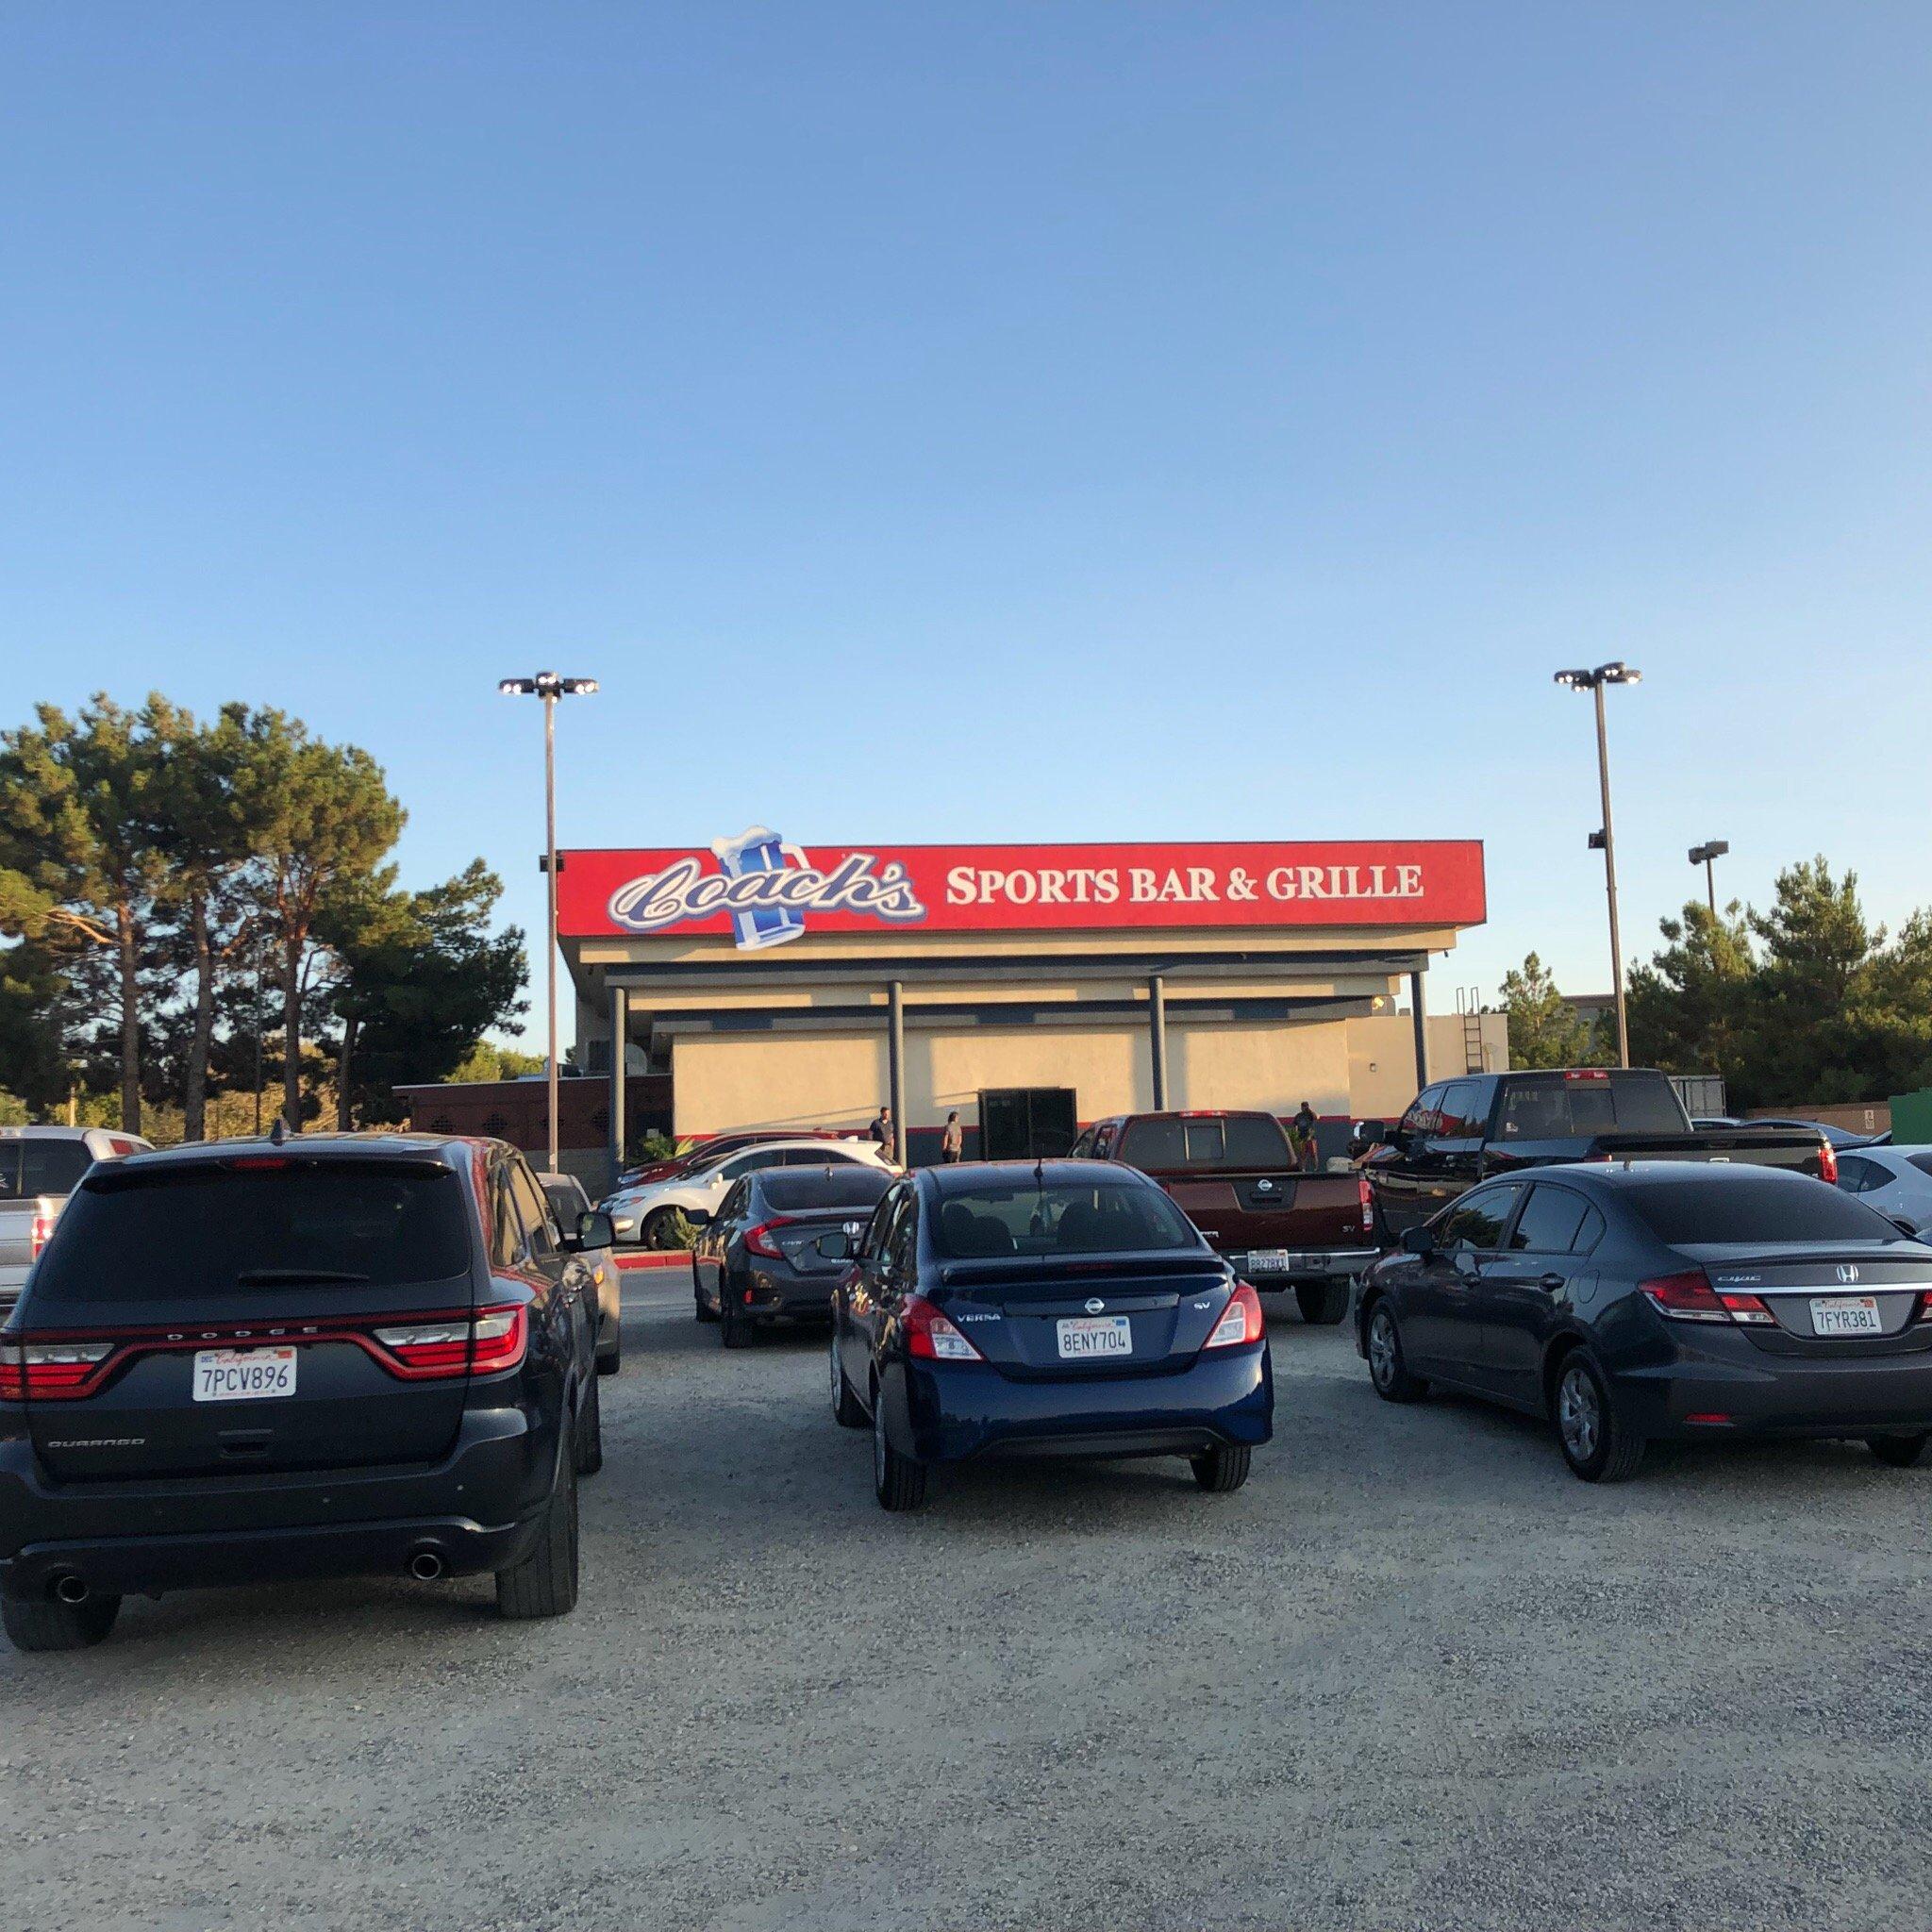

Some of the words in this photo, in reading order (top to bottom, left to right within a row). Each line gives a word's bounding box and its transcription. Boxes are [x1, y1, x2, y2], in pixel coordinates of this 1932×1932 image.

[608, 853, 926, 928] Coach's
[946, 866, 1120, 905] SPORTS
[1128, 867, 1220, 902] BAR
[1226, 867, 1259, 901] &
[1266, 865, 1424, 900] GRILLE
[957, 1313, 1001, 1322] VERSA
[1816, 1310, 1876, 1331] 7FYR381
[166, 1325, 318, 1341] DODGE
[1063, 1331, 1125, 1351] 8ENY704
[202, 1364, 289, 1393] 7PCV896
[48, 1438, 145, 1448] DURANGO
